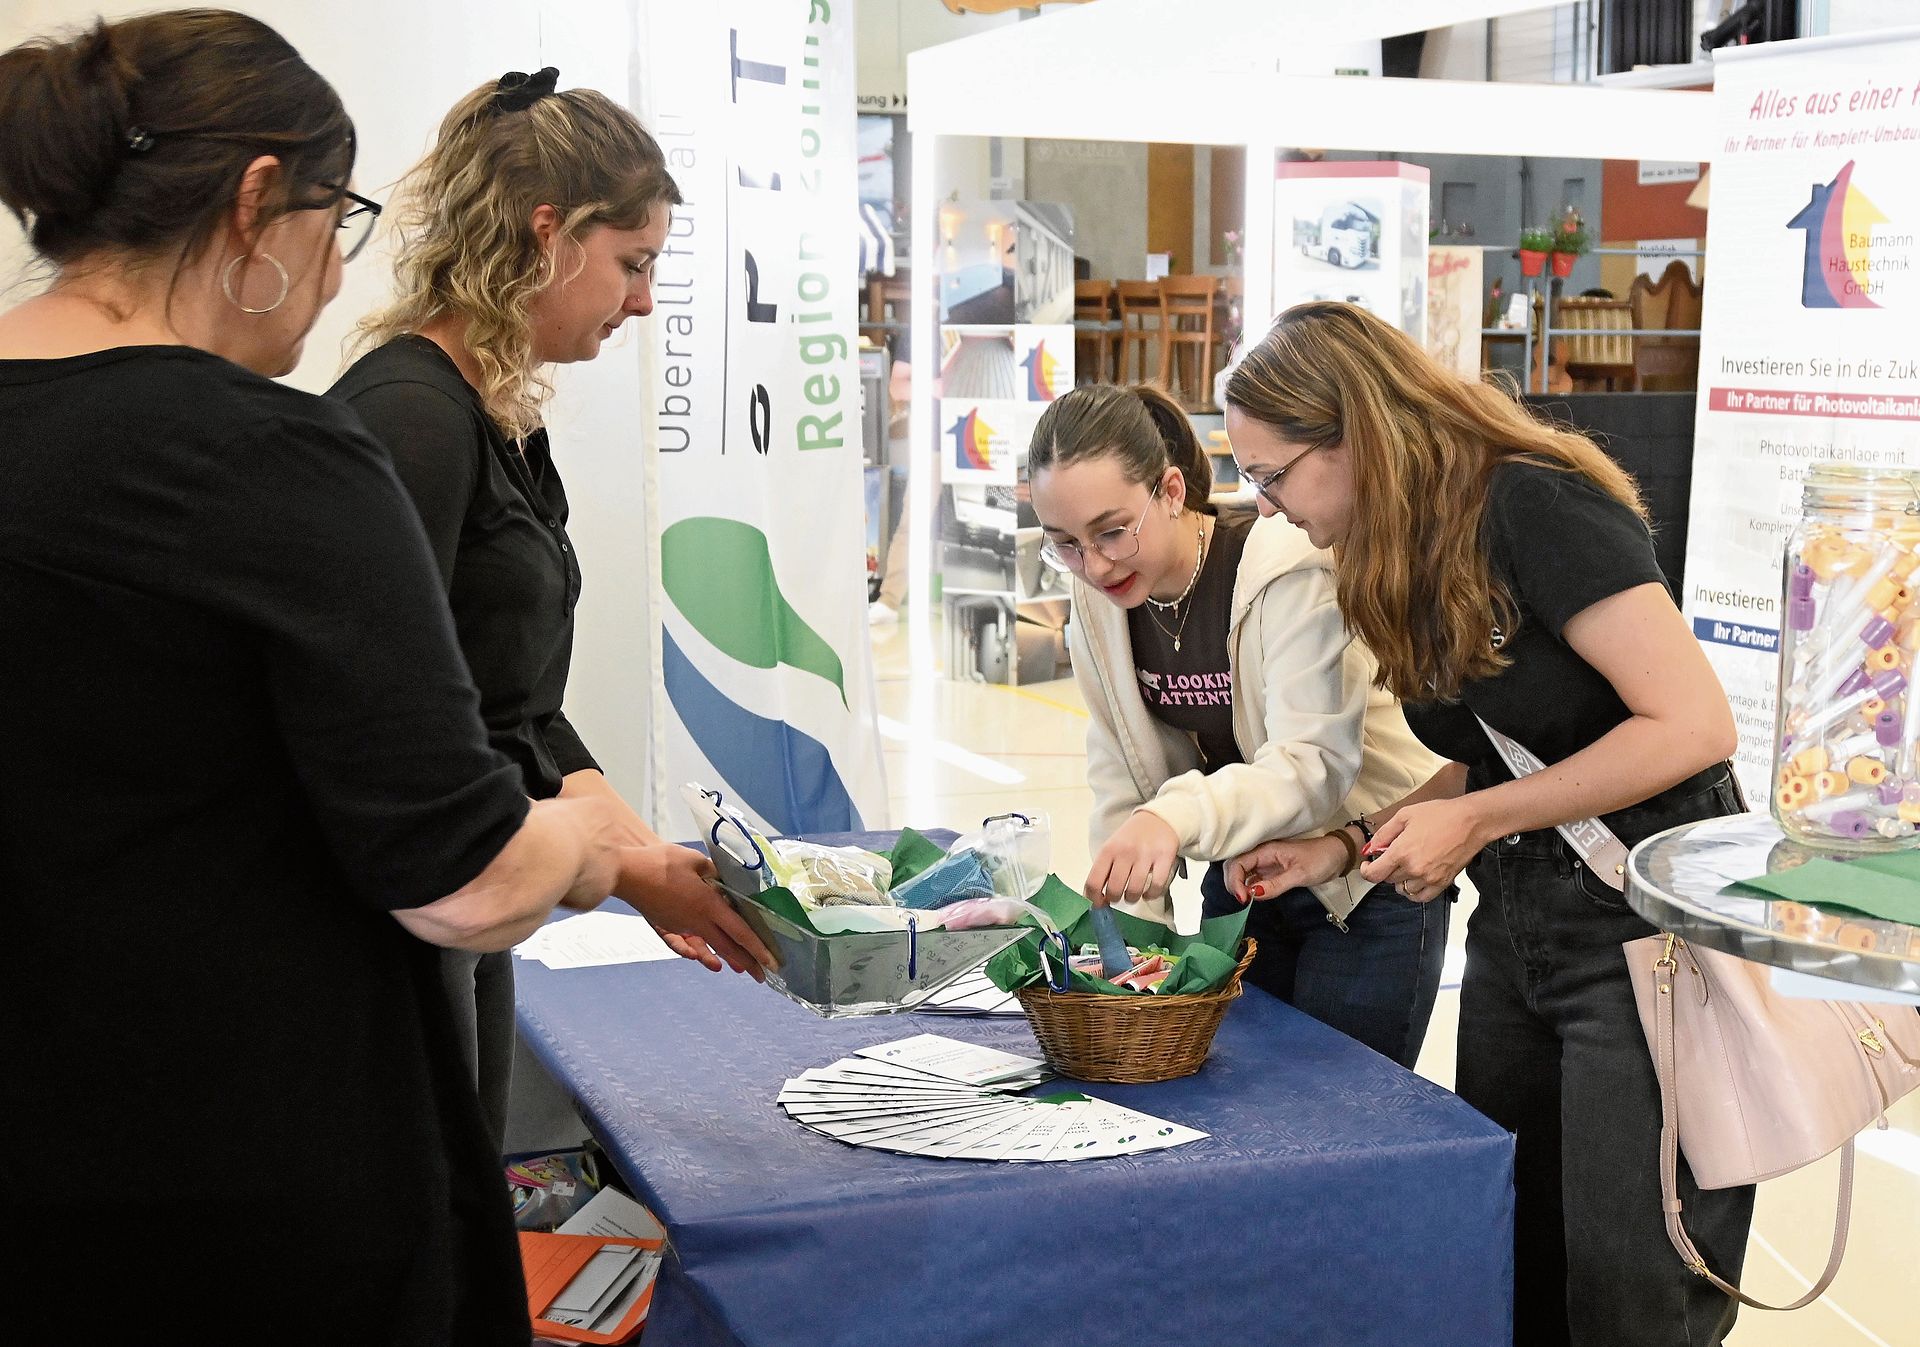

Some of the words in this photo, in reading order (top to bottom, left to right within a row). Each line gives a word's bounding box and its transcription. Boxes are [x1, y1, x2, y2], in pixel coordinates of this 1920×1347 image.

[1749, 89, 1798, 121] Alles
[1805, 90, 1842, 115] aus
[1849, 79, 1903, 112] einer
[1724, 136, 1741, 153] Ihr
[1744, 132, 1787, 152] Partner
[1791, 131, 1809, 149] für
[1813, 124, 1920, 150] Komplett-Umbau
[1849, 232, 1913, 249] Baumann
[1829, 254, 1911, 273] Haustechnik
[1843, 278, 1885, 296] GmbH
[1721, 354, 1804, 377] Investieren
[1809, 357, 1832, 378] Sie
[1837, 358, 1852, 378] in
[1857, 359, 1883, 379] die
[1727, 391, 1744, 408] Ihr
[1746, 393, 1791, 411] Partner
[1793, 393, 1812, 412] für
[1814, 395, 1920, 417] Photovoltaikanl
[1884, 448, 1906, 465] mit
[1694, 584, 1775, 613] Investieren
[1712, 622, 1730, 641] Ihr
[1731, 625, 1778, 648] Partner
